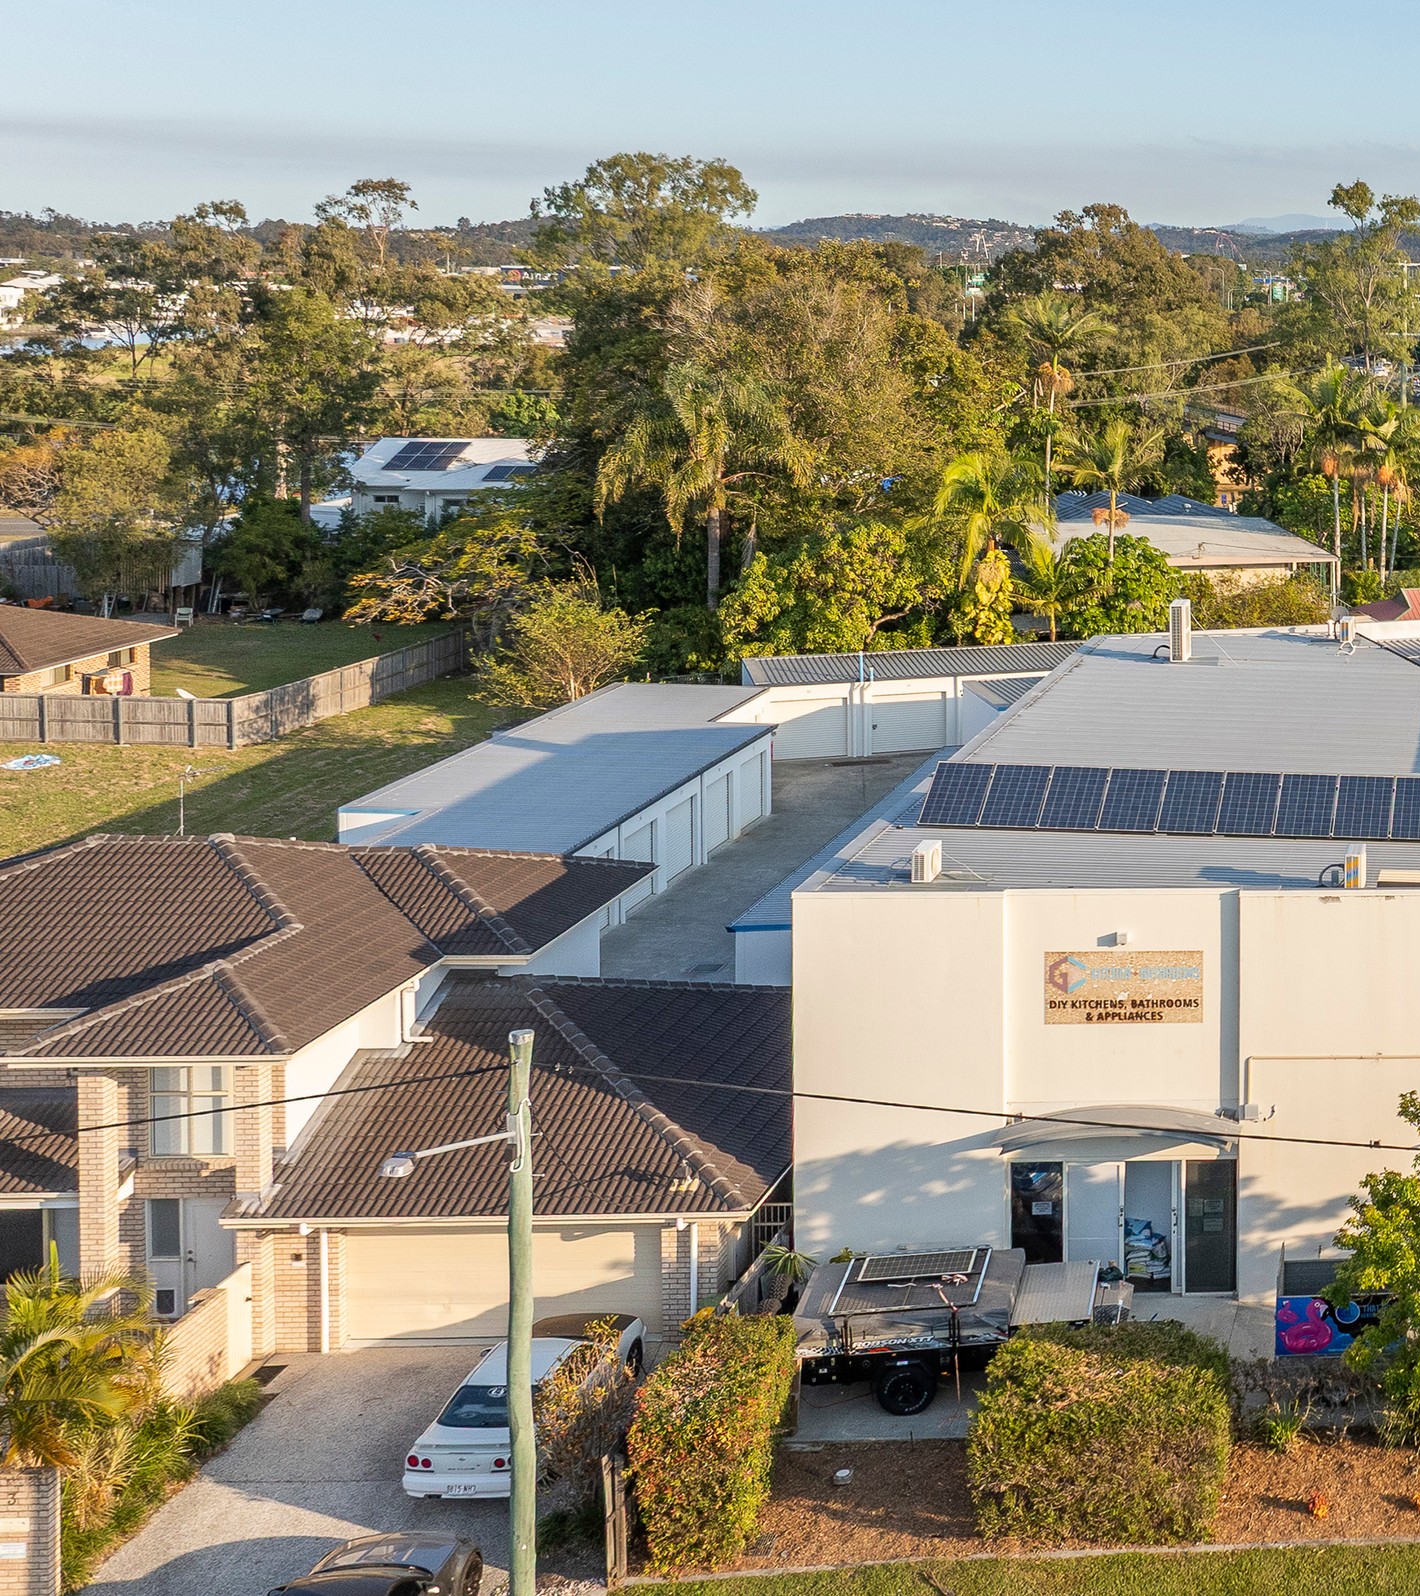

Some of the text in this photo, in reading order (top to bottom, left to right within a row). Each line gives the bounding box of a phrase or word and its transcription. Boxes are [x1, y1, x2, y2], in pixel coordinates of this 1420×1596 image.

[1050, 998, 1200, 1010] DIY KITCHENS, BATHROOMS
[1085, 1011, 1164, 1021] & APPLIANCES
[7, 1492, 17, 1506] 3
